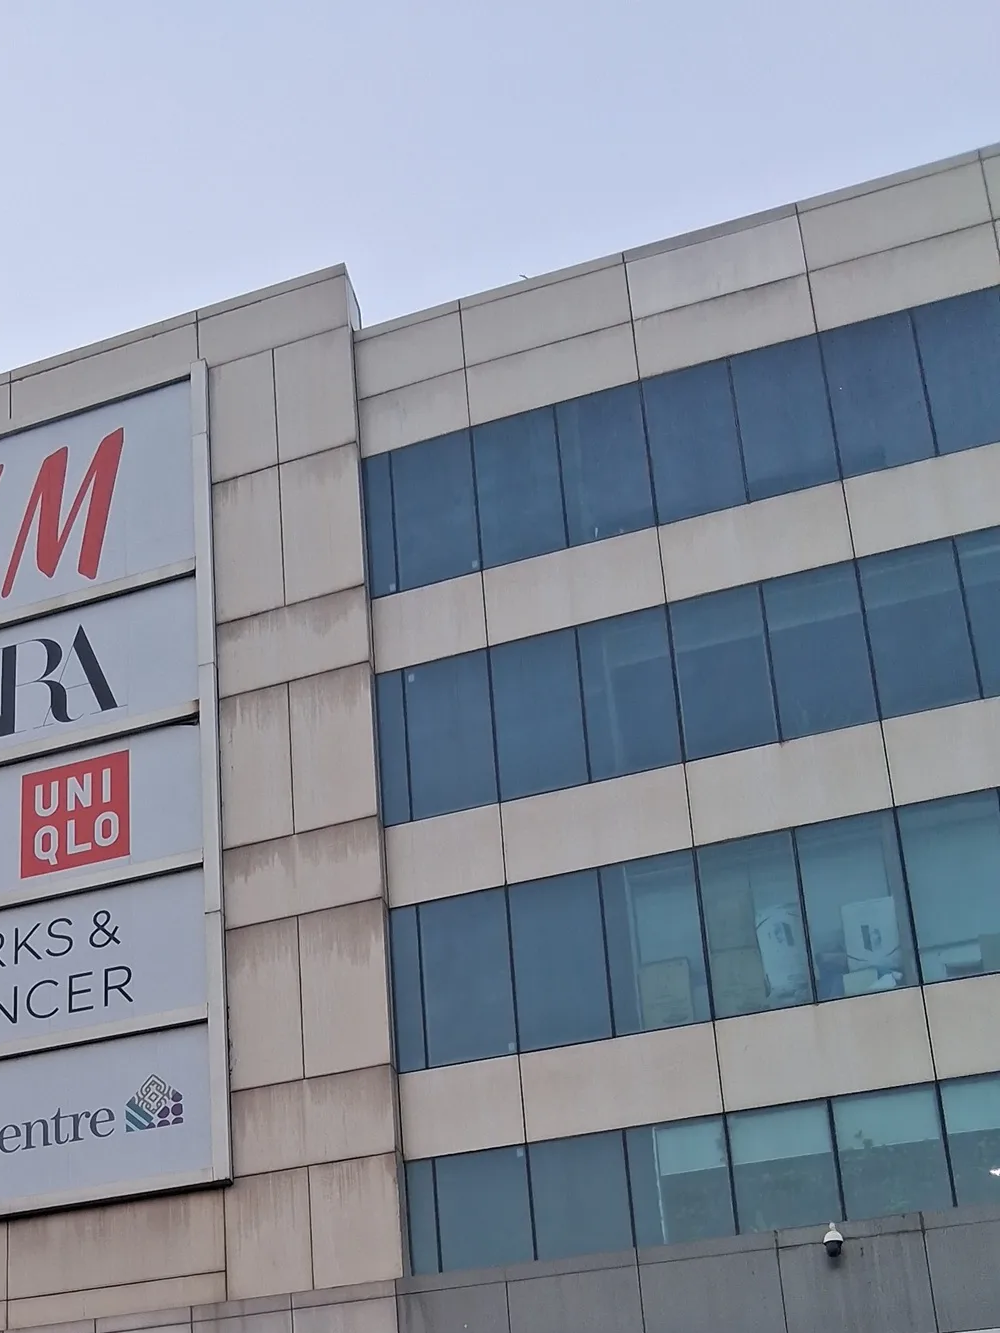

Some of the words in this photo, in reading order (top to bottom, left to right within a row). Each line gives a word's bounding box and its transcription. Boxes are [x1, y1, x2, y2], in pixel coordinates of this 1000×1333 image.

[34, 767, 112, 817] UNI
[34, 810, 120, 866] QLO
[89, 909, 122, 948] &
